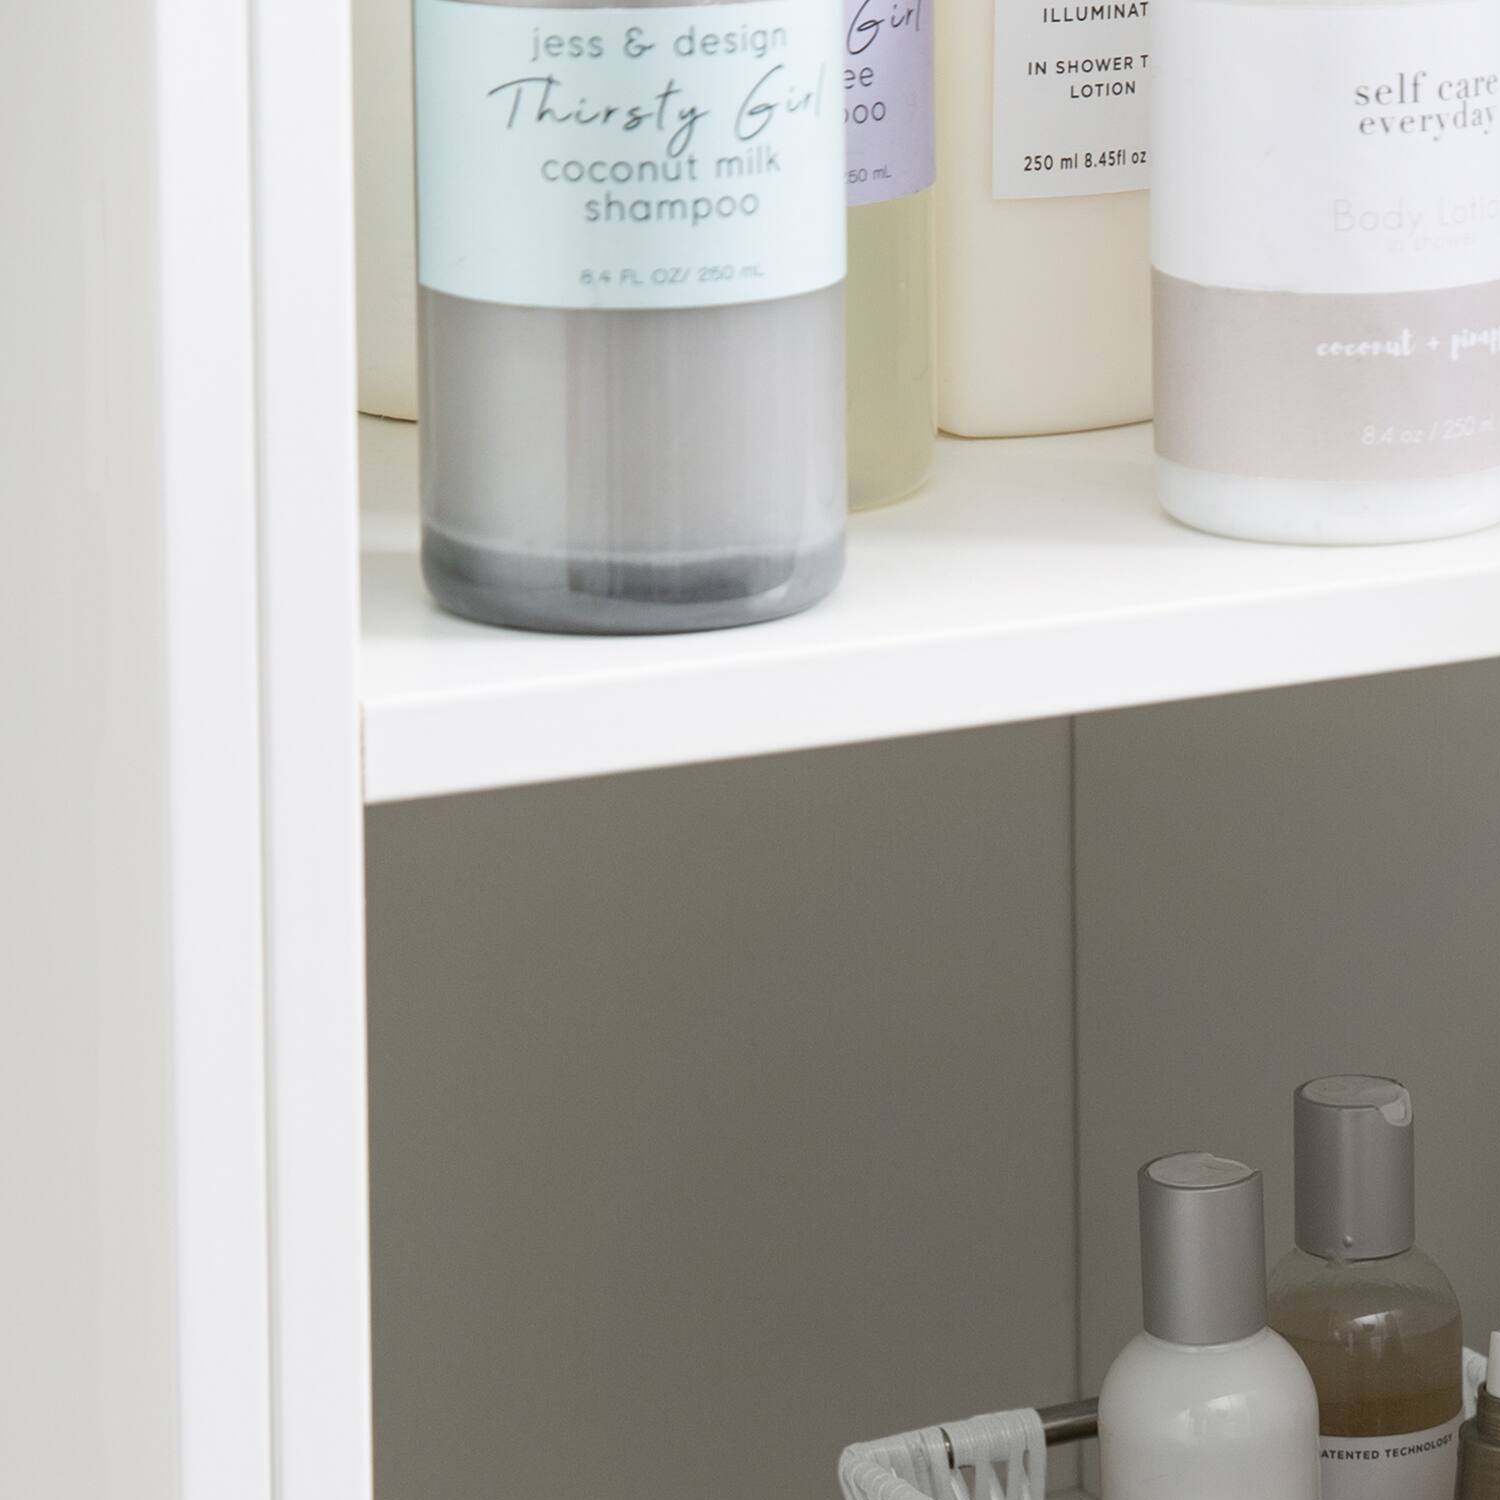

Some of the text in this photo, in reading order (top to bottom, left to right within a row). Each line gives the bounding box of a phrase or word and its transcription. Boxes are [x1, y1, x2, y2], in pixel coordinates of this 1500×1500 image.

[531, 24, 788, 62] jess & design
[846, 0, 922, 56] Girl
[1028, 61, 1047, 76] IN
[1056, 56, 1134, 74] SHOWER
[1070, 81, 1136, 99] LOTION
[1354, 71, 1499, 107] self care
[487, 63, 828, 157] Thirsty Girl
[1359, 101, 1497, 141] everyday
[541, 146, 782, 184] coconut milk
[1024, 149, 1147, 172] 250 ml 8.45fl oz
[584, 192, 760, 227] shampoo
[1333, 195, 1423, 238] Body
[619, 267, 645, 287] FL
[697, 264, 735, 285] 250
[1316, 327, 1416, 358] coconut
[1400, 428, 1424, 444] oz
[1442, 415, 1476, 440] 250
[1385, 1433, 1453, 1458] TECHNOLOGY
